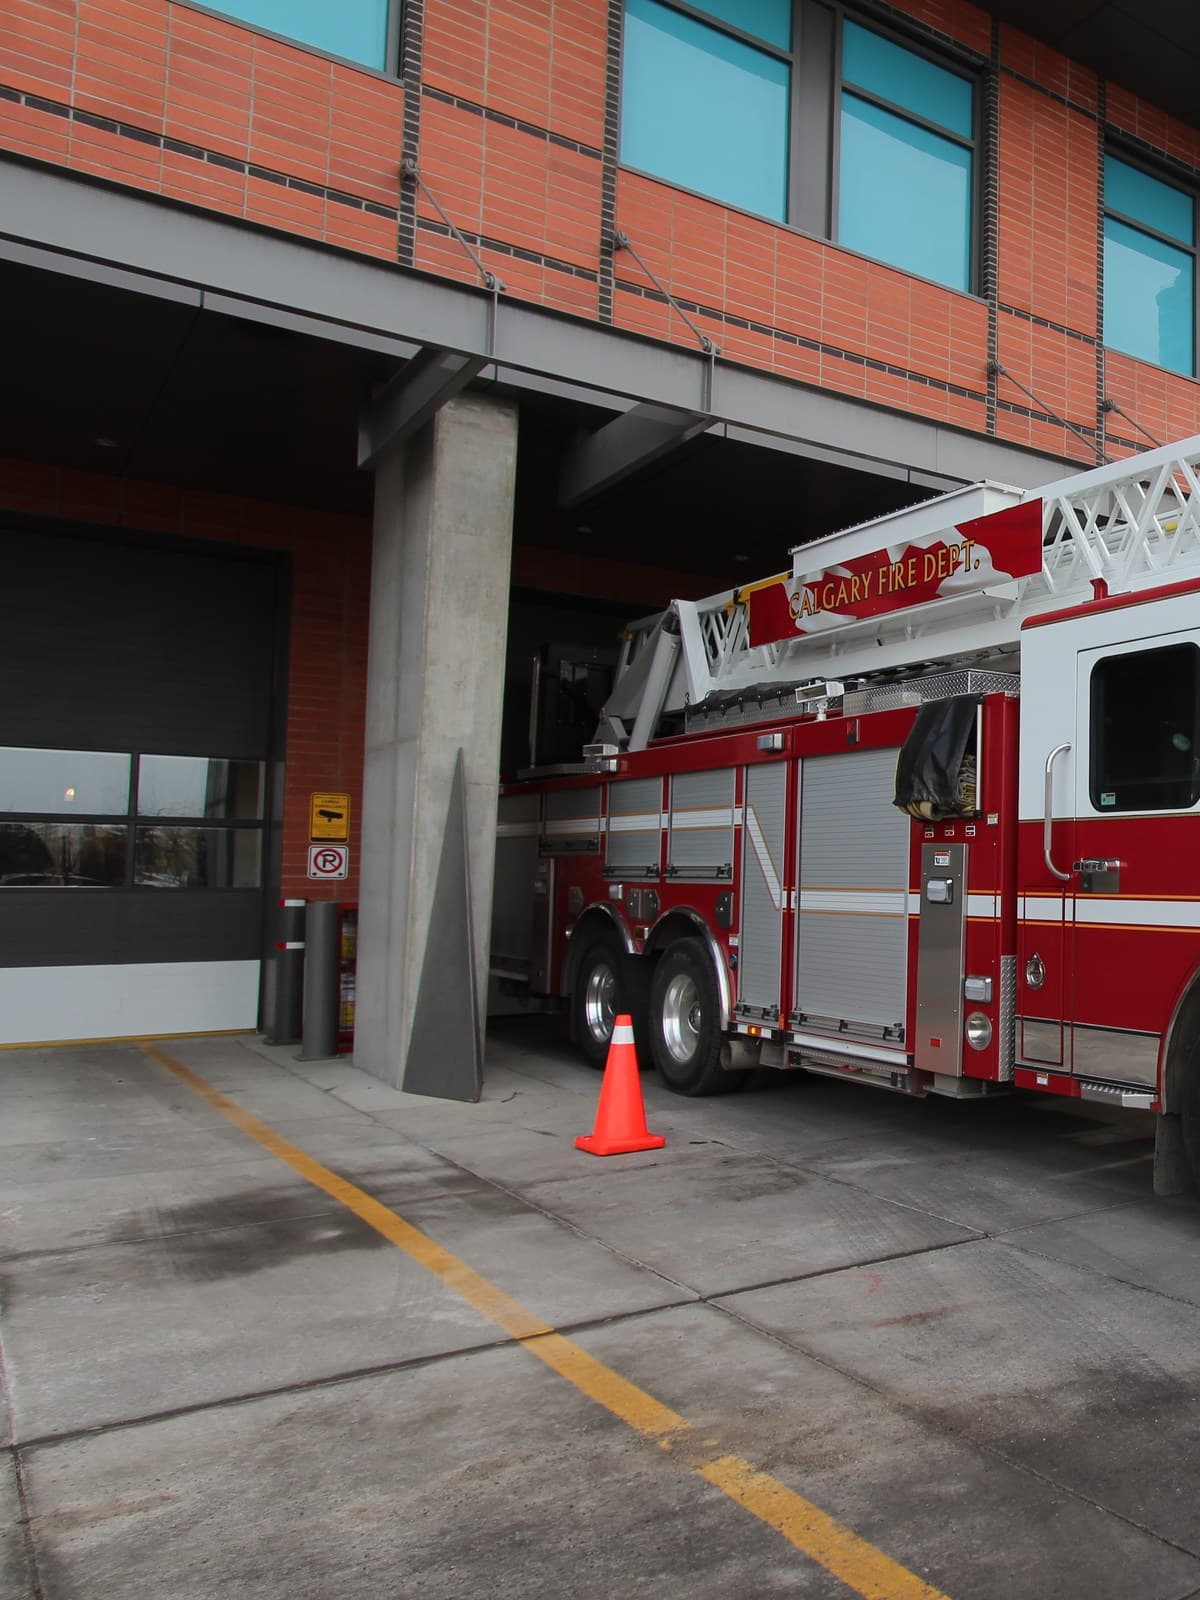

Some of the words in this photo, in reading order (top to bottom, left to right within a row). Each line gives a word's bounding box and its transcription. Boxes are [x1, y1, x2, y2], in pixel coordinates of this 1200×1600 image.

[789, 572, 873, 619] CALGARY
[878, 558, 917, 595] FIRE
[923, 539, 980, 580] DEPT.
